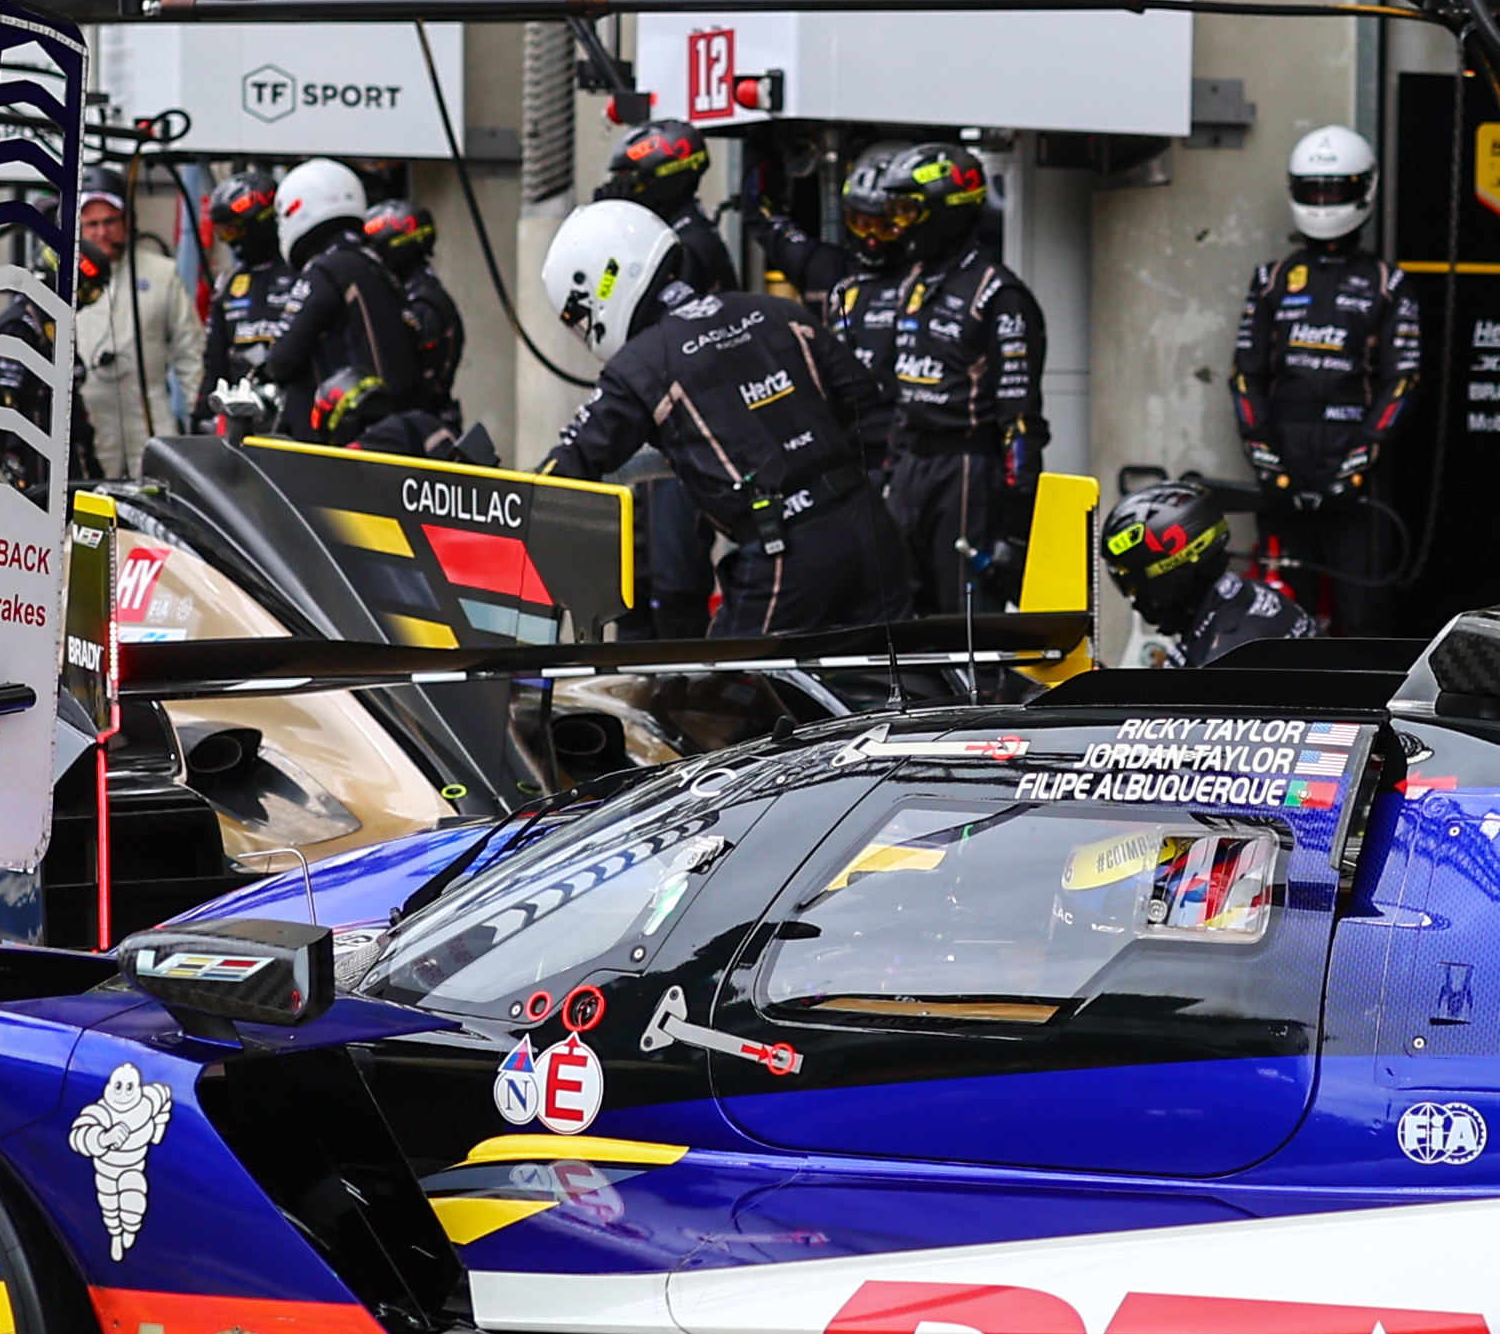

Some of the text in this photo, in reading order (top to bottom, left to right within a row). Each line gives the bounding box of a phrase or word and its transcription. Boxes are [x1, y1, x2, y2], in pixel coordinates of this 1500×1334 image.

[691, 34, 731, 114] 12
[251, 84, 402, 109] TF SPORT
[682, 310, 766, 355] CADILLAC
[1289, 323, 1349, 346] Hertz
[739, 369, 794, 407] Hertz
[401, 477, 523, 530] CADILLAC
[116, 558, 162, 610] HY
[68, 635, 102, 673] BRADY
[1116, 719, 1306, 744] RICKY TAYLOR
[1073, 743, 1296, 774] JORDAN TAYLOR
[1014, 773, 1287, 806] FILIPE ALBUQUERQUE
[504, 1078, 531, 1112] N
[546, 1052, 587, 1123] E
